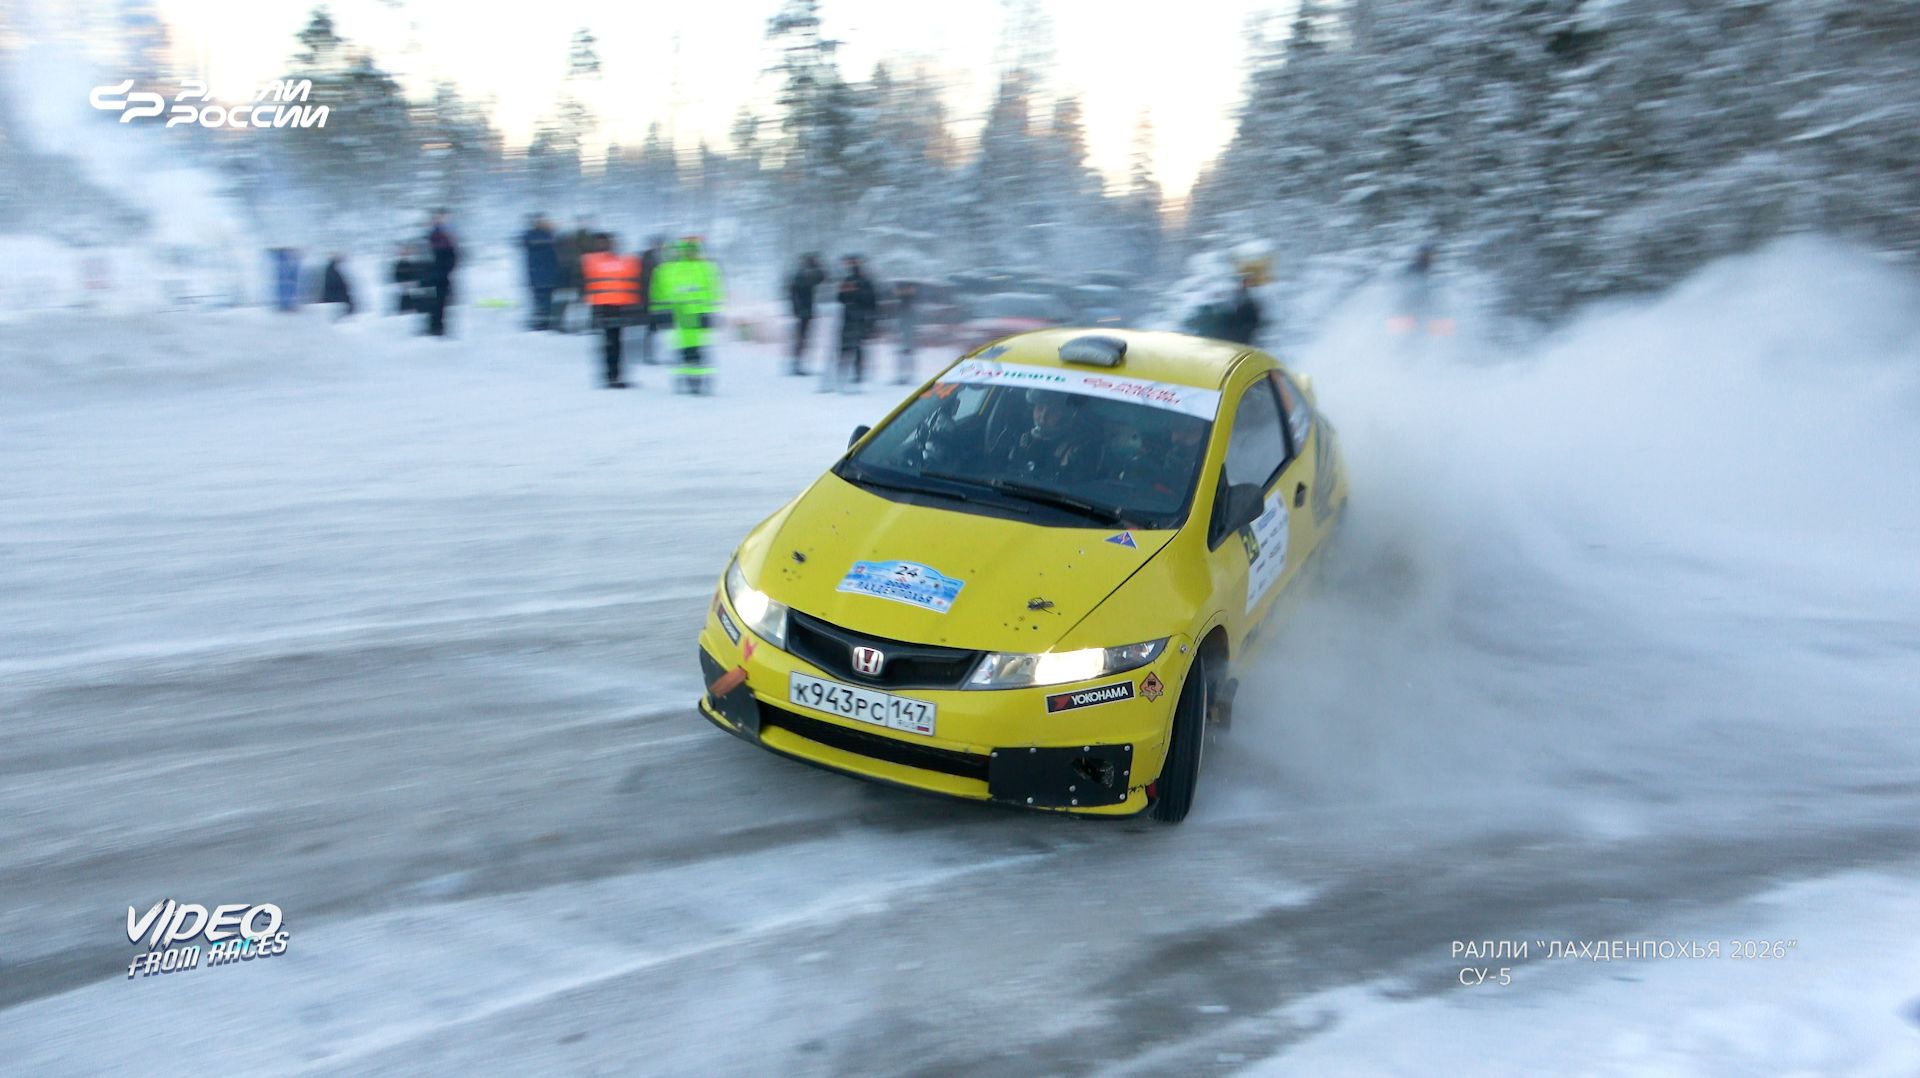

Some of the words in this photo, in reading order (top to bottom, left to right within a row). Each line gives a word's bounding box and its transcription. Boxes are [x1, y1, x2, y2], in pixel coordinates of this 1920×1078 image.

[894, 565, 919, 578] 24
[1071, 686, 1129, 706] YOKOHAMA
[891, 700, 928, 723] 147
